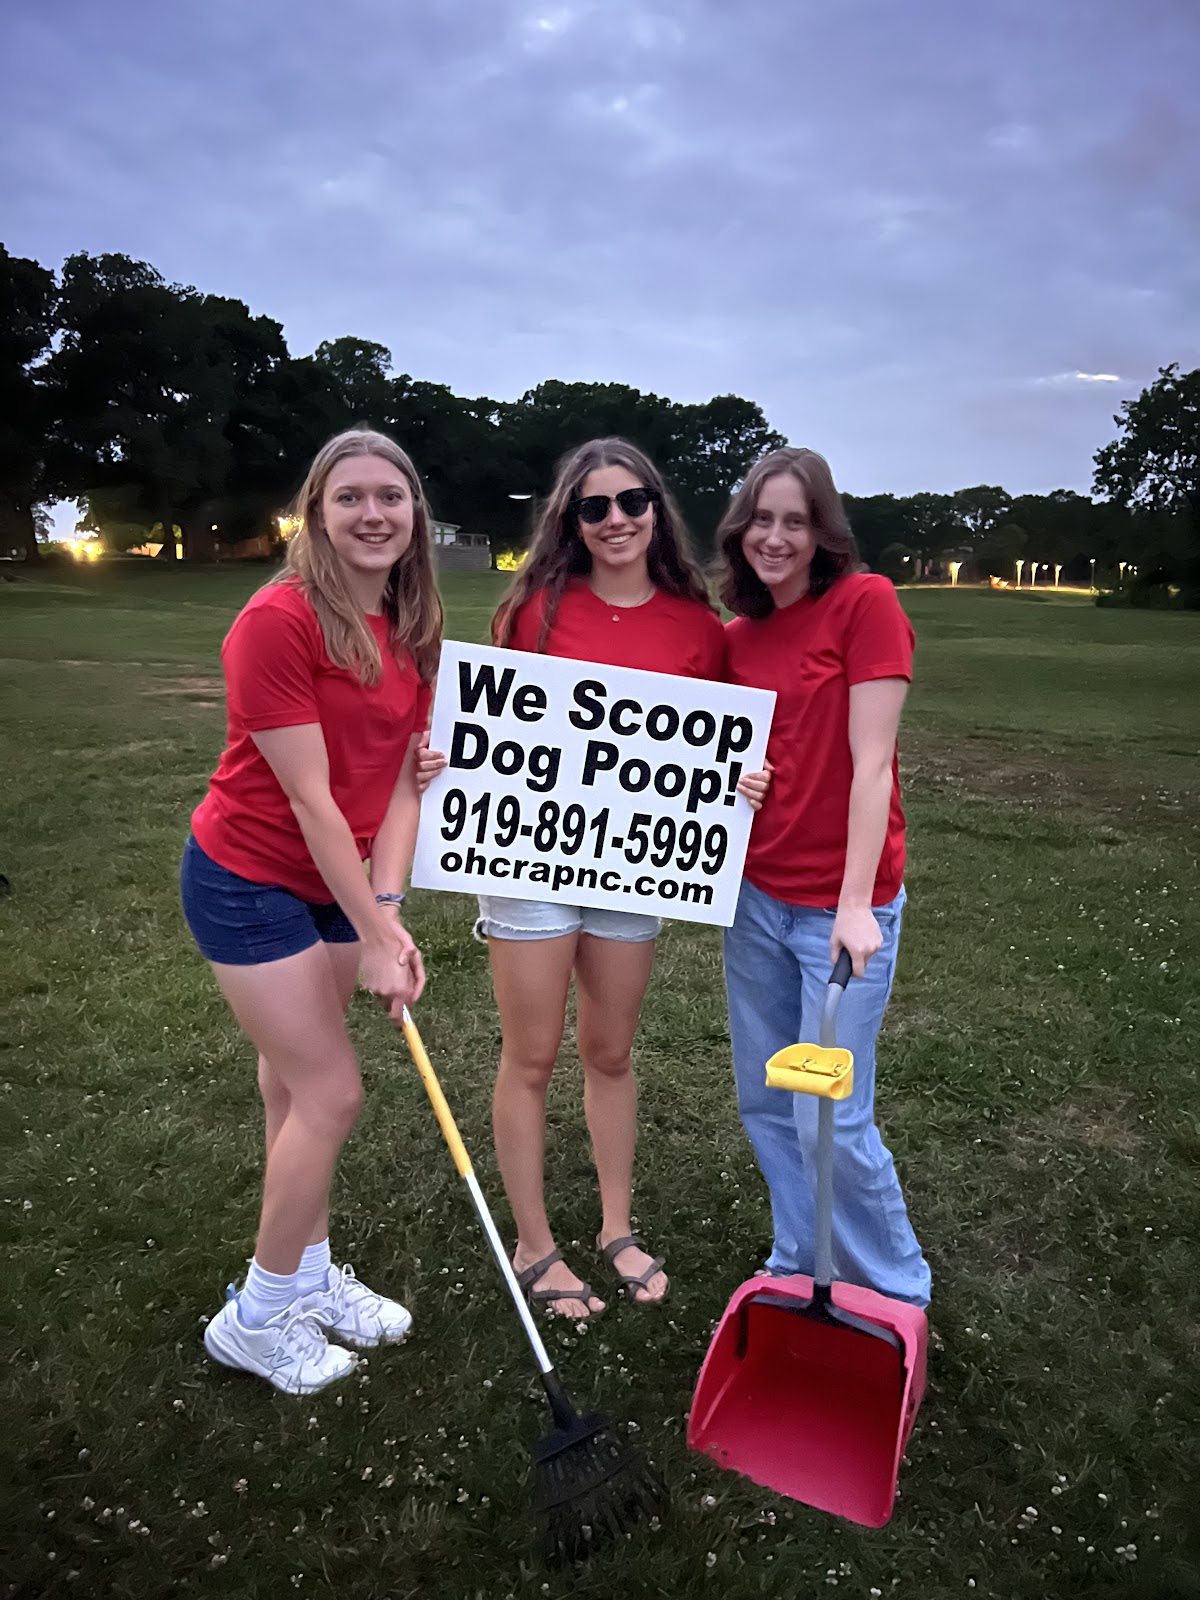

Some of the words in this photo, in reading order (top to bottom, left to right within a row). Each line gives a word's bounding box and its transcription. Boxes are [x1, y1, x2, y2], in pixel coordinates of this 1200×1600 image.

[458, 660, 547, 723] We
[568, 679, 754, 764] Scoop
[448, 721, 562, 793] Dog
[581, 739, 743, 814] Poop!
[440, 788, 729, 876] 919-891-5999
[440, 847, 714, 905] ohcrapnc.com
